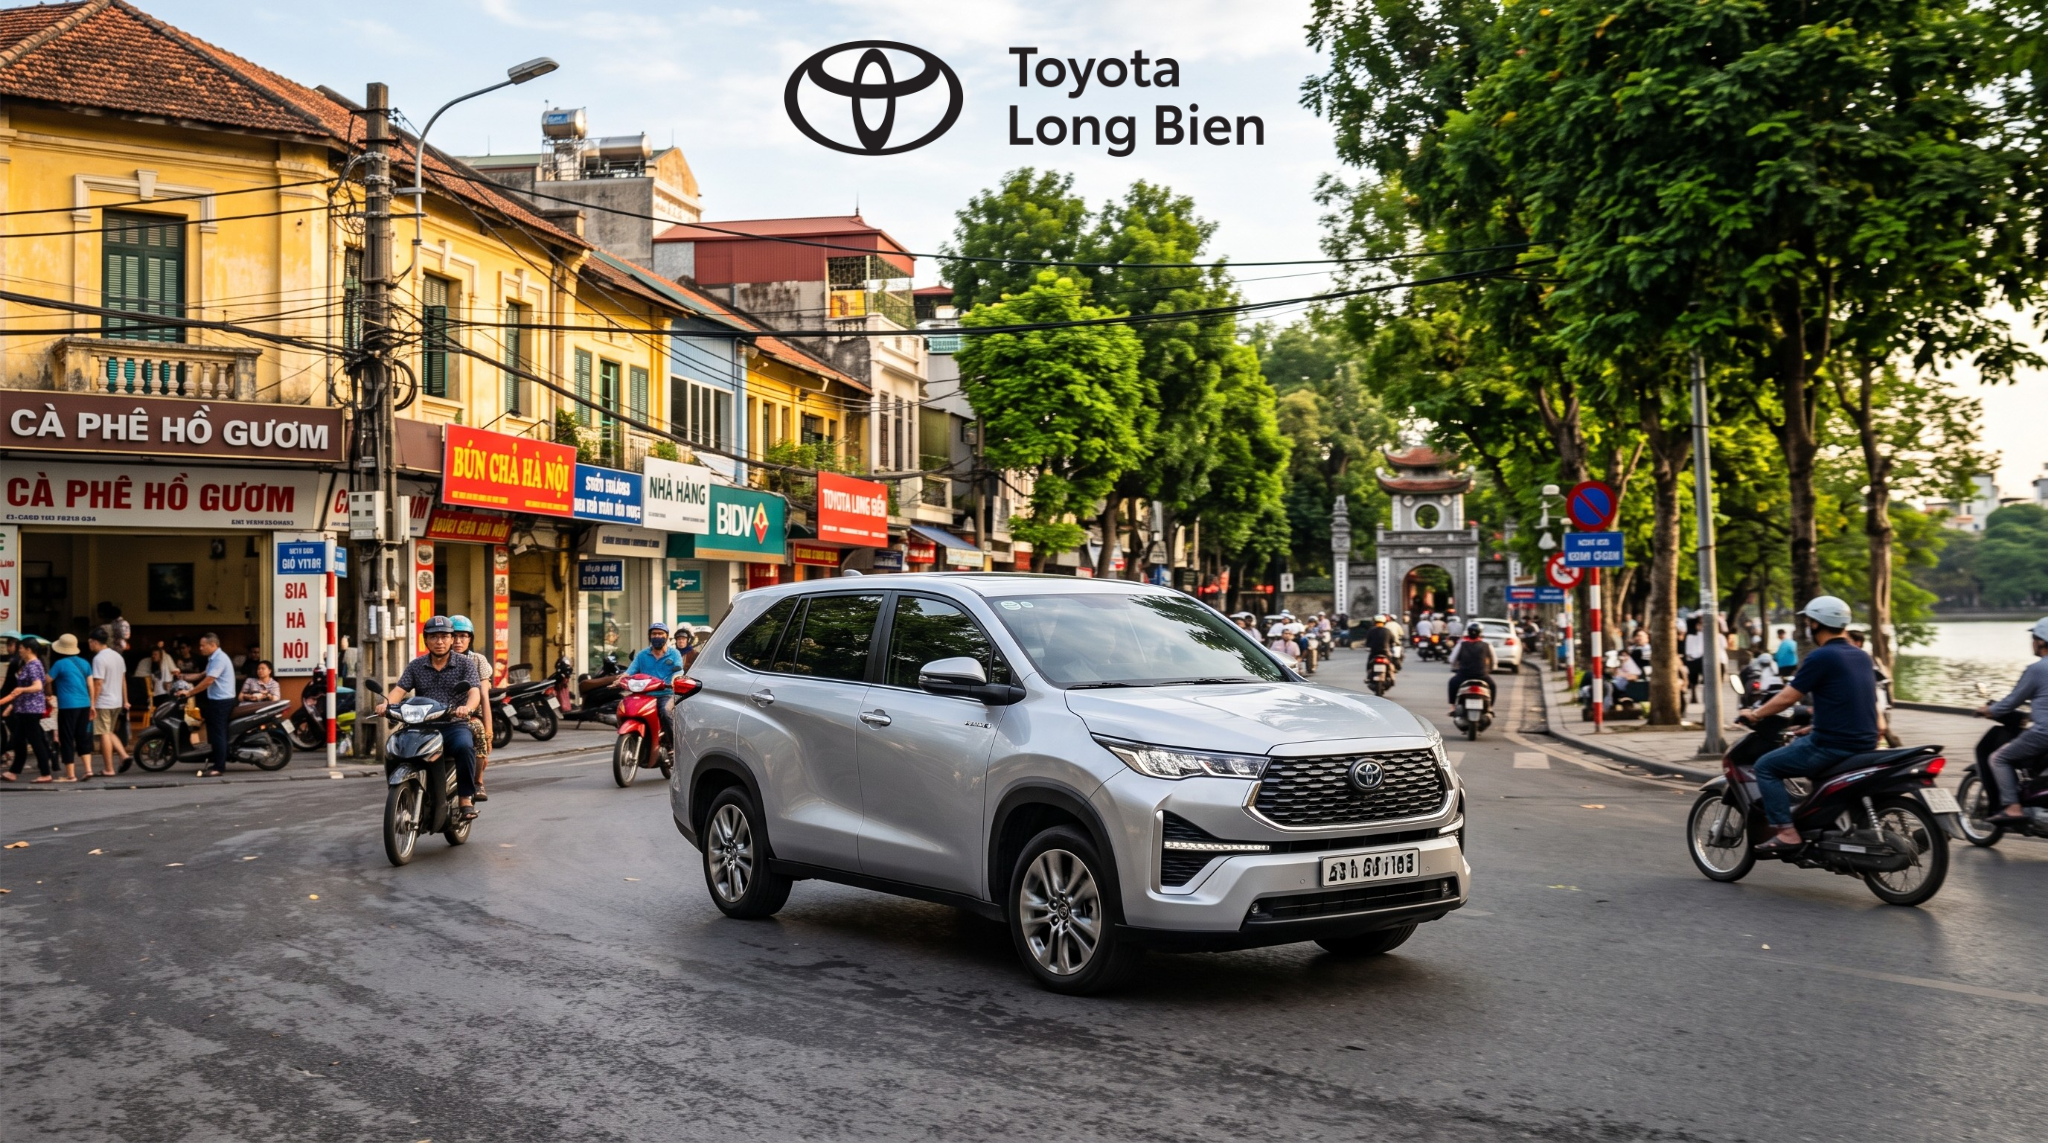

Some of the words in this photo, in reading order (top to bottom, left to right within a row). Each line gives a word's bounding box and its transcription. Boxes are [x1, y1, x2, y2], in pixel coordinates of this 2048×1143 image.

[10, 403, 66, 438] CÀ
[78, 407, 149, 441] PHÊ
[162, 404, 213, 445] HỒ
[223, 418, 329, 450] GƯƠM
[452, 439, 487, 481] BÚN
[521, 451, 543, 489] HÀ
[544, 455, 570, 499] NỘI
[7, 472, 55, 507] CÀ
[66, 475, 133, 509] PHÊ
[144, 473, 189, 511] HỒ
[200, 482, 295, 513] GƯƠM
[649, 473, 673, 501] NHÀ
[676, 475, 706, 505] HÀNG
[716, 502, 755, 538] BIDV
[286, 608, 306, 629] HÀ
[283, 638, 309, 663] NỘI
